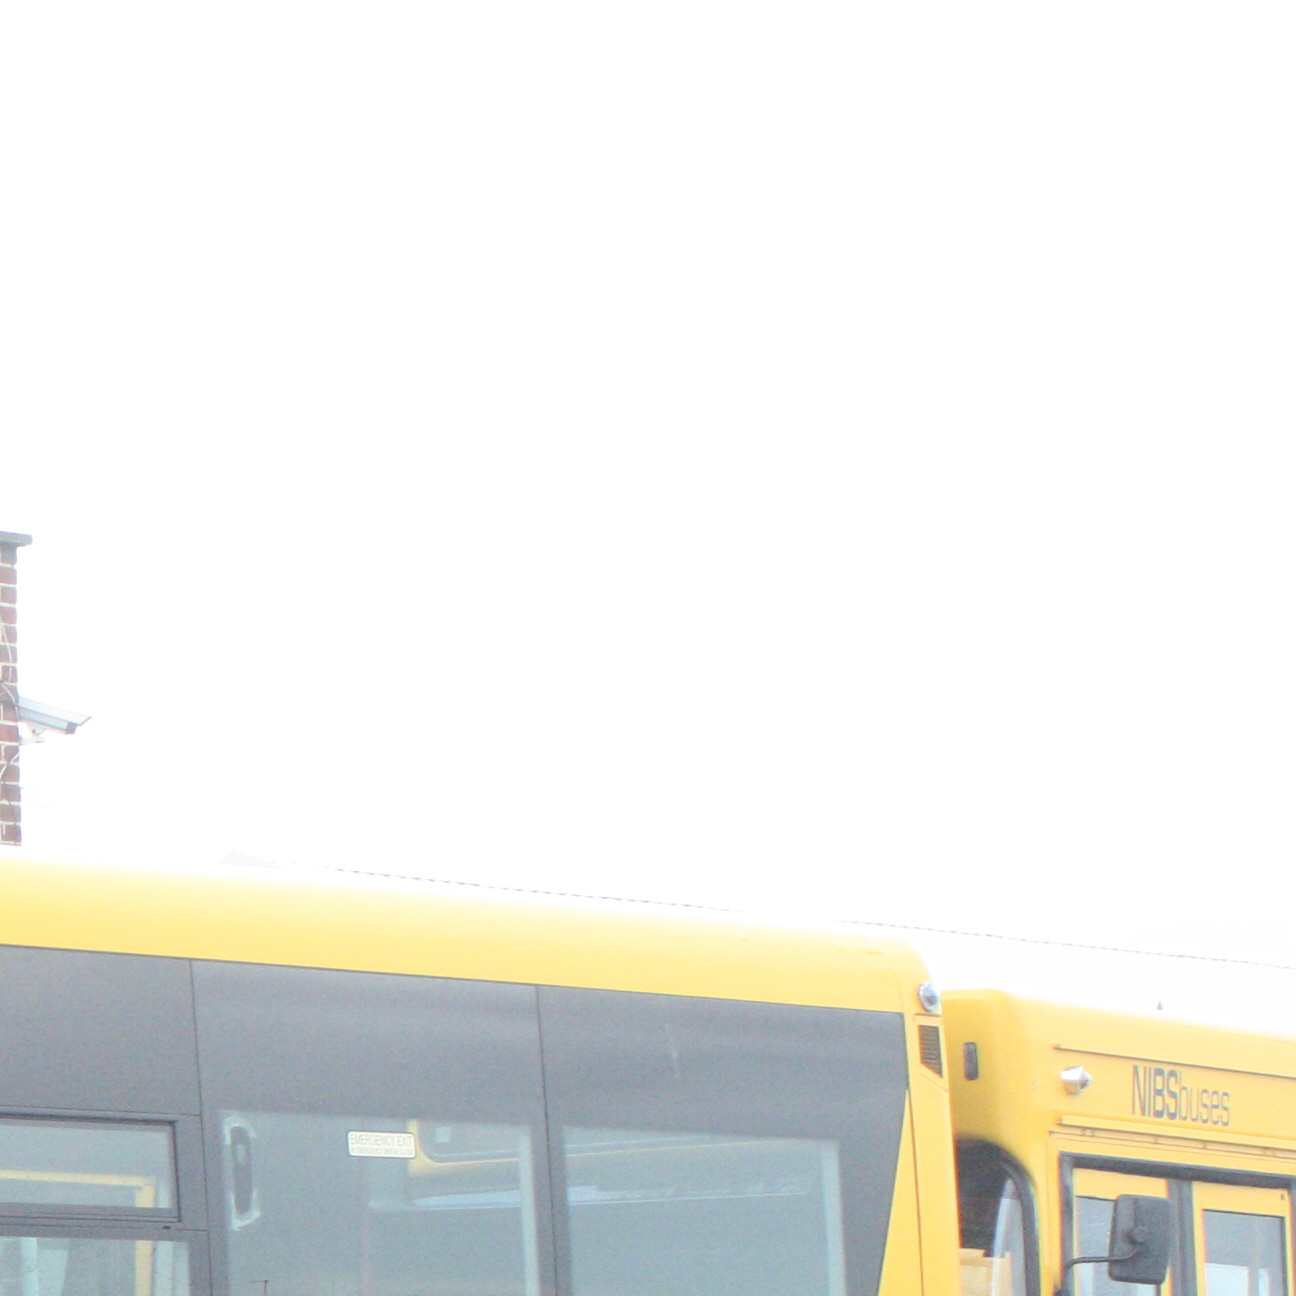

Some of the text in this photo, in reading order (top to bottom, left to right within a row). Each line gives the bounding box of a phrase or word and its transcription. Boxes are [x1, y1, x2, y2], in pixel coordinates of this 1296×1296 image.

[1131, 1064, 1230, 1126] NIBSbuses
[350, 1134, 413, 1146] EMERGENCY EXIT
